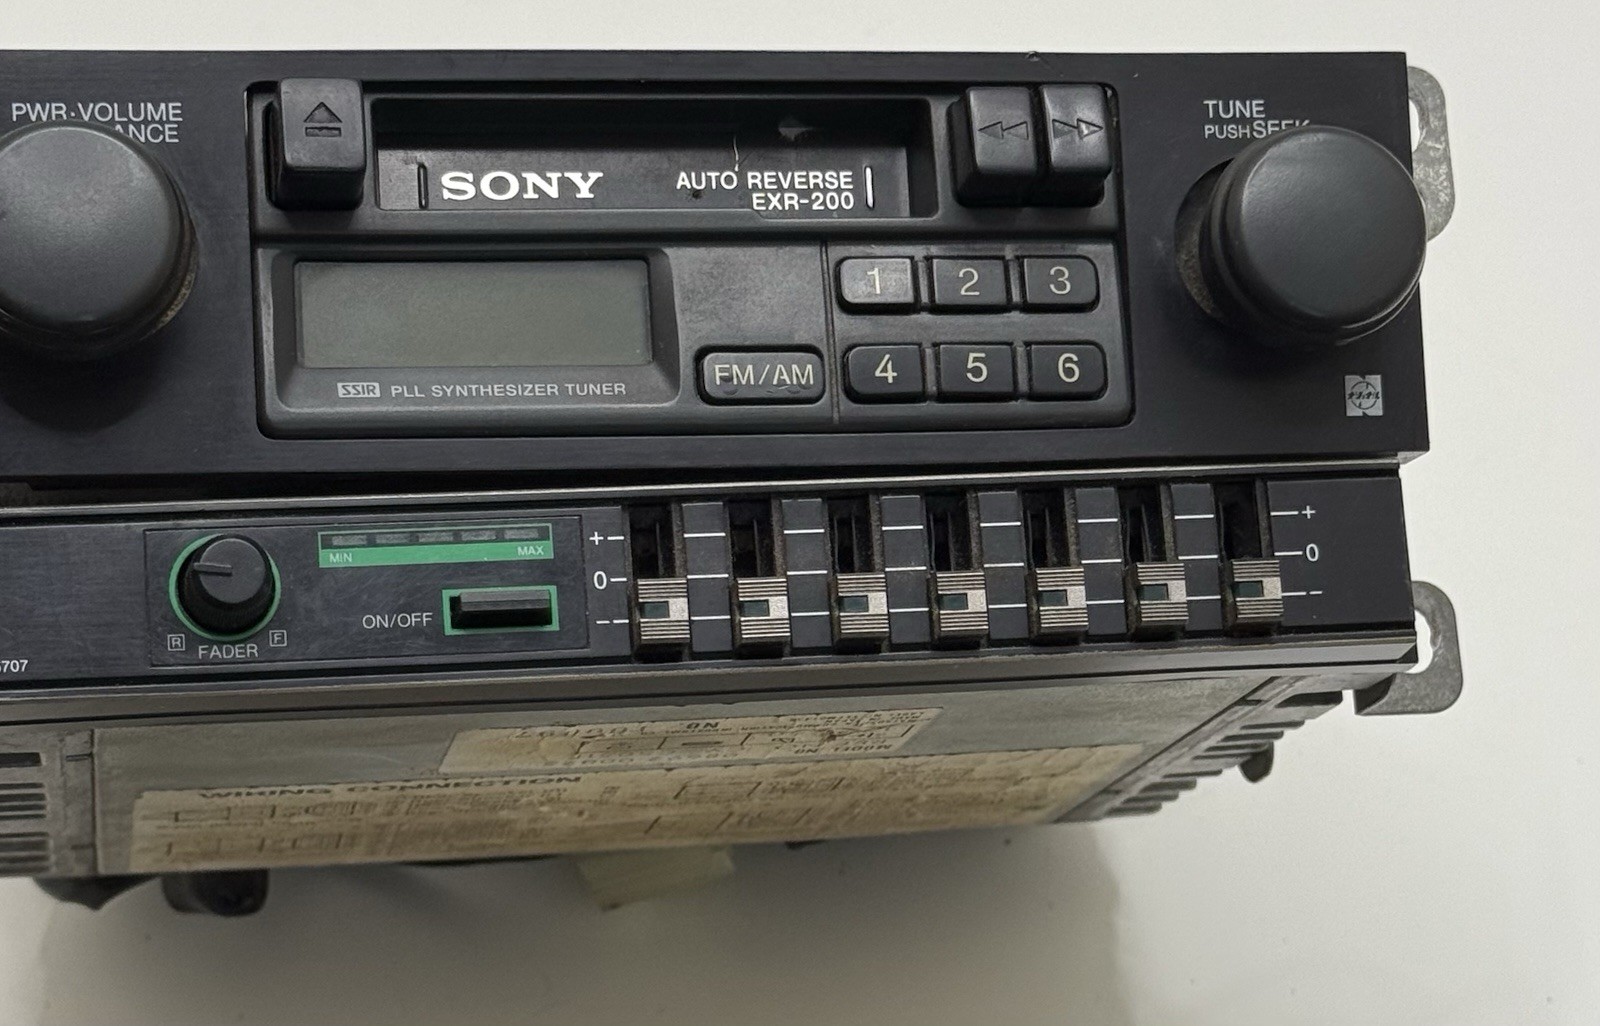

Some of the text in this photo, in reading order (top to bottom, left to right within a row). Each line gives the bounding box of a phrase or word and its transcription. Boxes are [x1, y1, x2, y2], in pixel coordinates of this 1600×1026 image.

[1203, 100, 1266, 119] TUNE
[1204, 124, 1251, 139] PUSH
[441, 171, 604, 200] SONY
[676, 171, 854, 191] AUTO REVERSE
[752, 192, 855, 211] EXR-200
[867, 266, 1072, 296] 1 2 3
[715, 363, 814, 387] FM/AM
[874, 353, 1081, 384] 4 5 6
[391, 385, 425, 398] PLL
[431, 383, 559, 397] SYNTHESIZER
[565, 383, 627, 396] TUNER
[329, 552, 352, 563] MIN
[517, 546, 544, 556] MAX
[1306, 543, 1319, 562] 0
[593, 571, 607, 590] 0
[362, 612, 433, 629] ON/OFF
[198, 643, 259, 660] FADER
